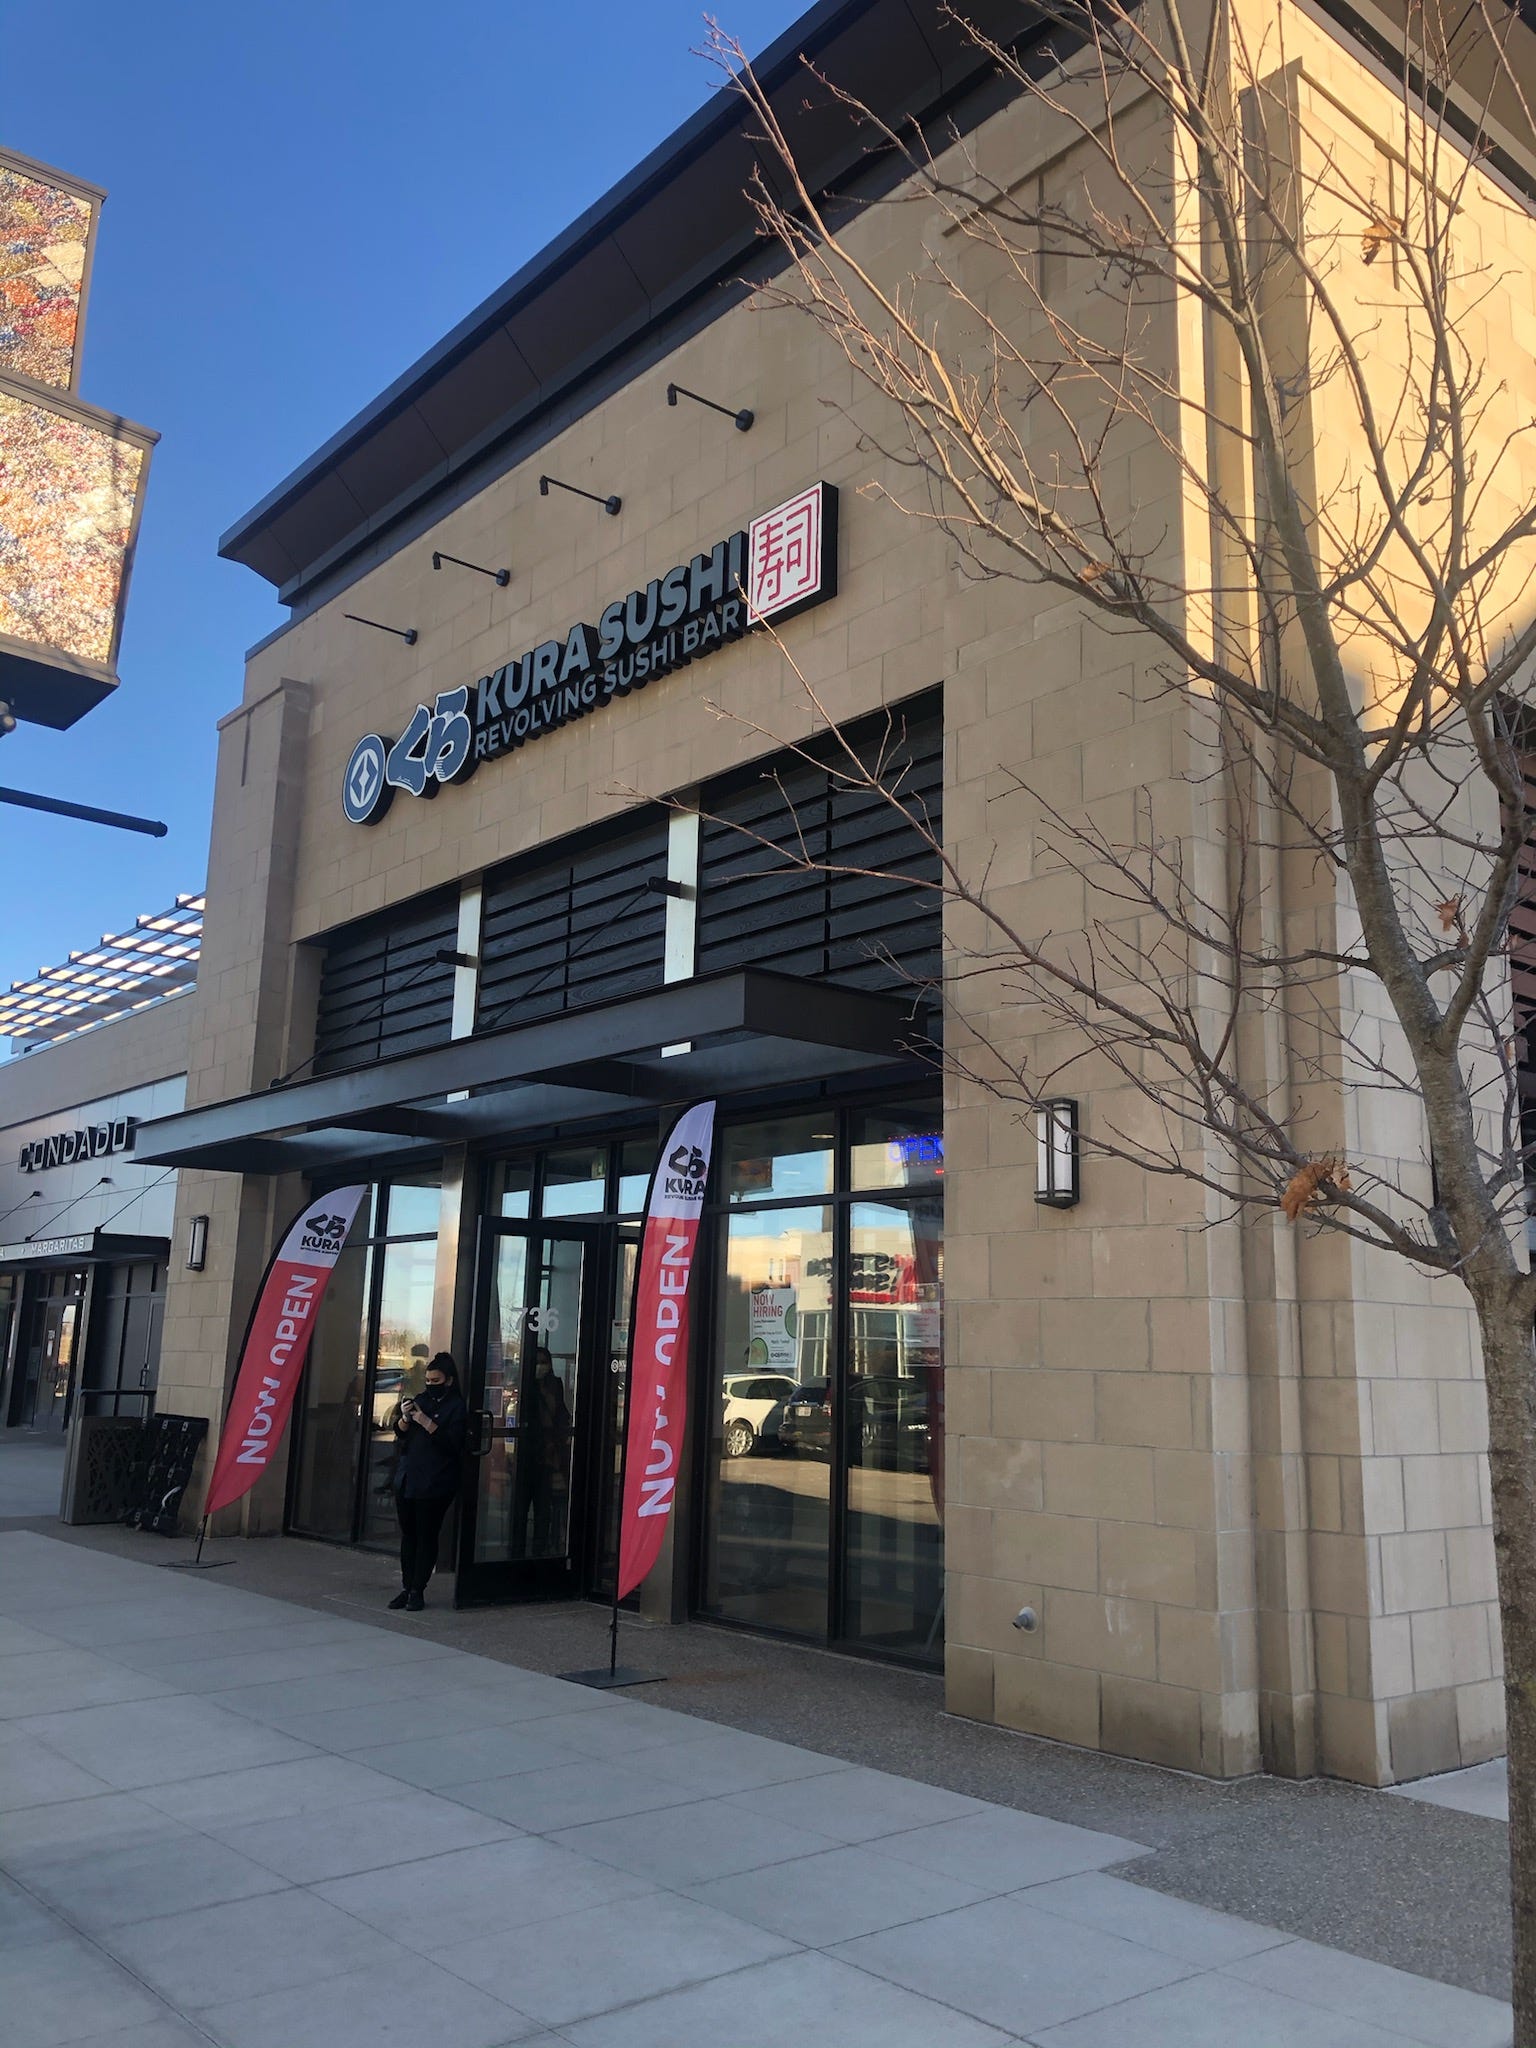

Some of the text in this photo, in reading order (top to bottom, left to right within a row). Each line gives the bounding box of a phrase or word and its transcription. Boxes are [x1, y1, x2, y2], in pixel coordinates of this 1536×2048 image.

[476, 530, 746, 727] KURA SUSHI
[474, 599, 740, 760] REVOLVING SUSHI BAR
[18, 1115, 129, 1173] CONDADO
[31, 1237, 86, 1255] MARGARITAS
[301, 1235, 341, 1251] KURA
[511, 1306, 560, 1333] 736
[753, 1305, 784, 1317] HIRING
